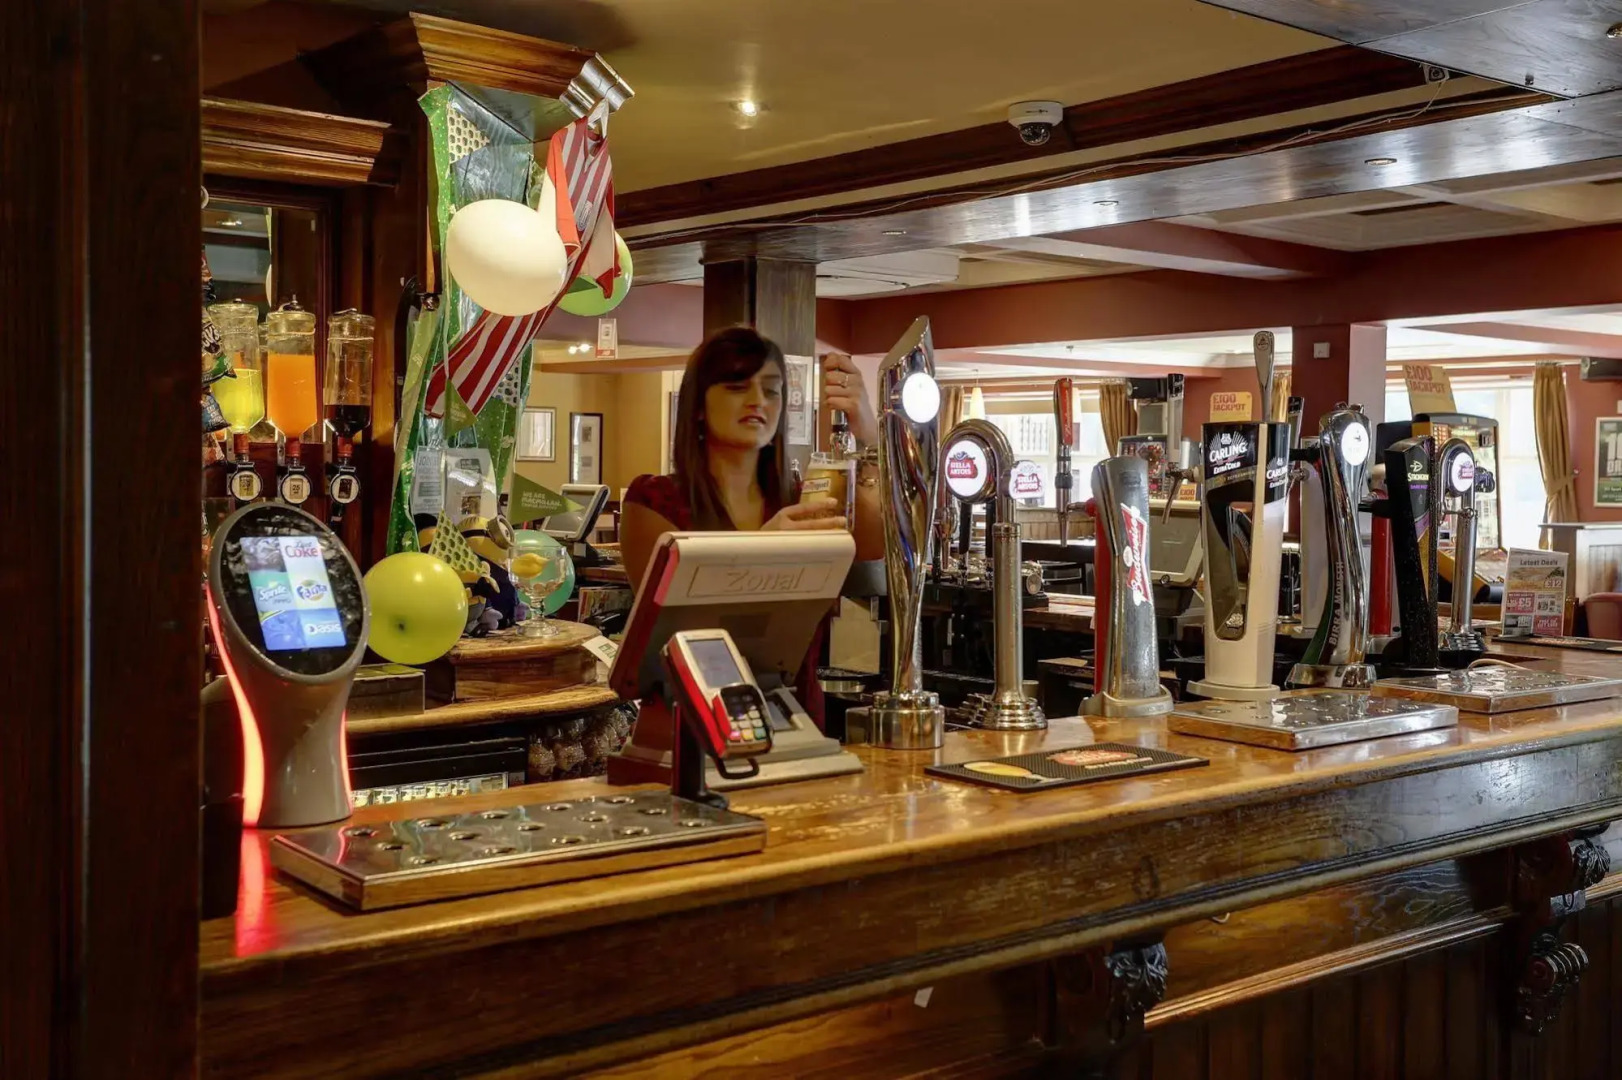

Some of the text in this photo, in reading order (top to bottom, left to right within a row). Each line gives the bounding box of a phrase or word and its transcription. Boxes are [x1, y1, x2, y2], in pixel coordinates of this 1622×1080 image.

[1410, 381, 1445, 393] JACKPOT
[1214, 403, 1246, 411] JACKPOT
[1209, 442, 1247, 462] CARLING
[723, 567, 806, 593] Zonal
[296, 584, 328, 600] Fanta
[1328, 608, 1341, 646] BIRRA
